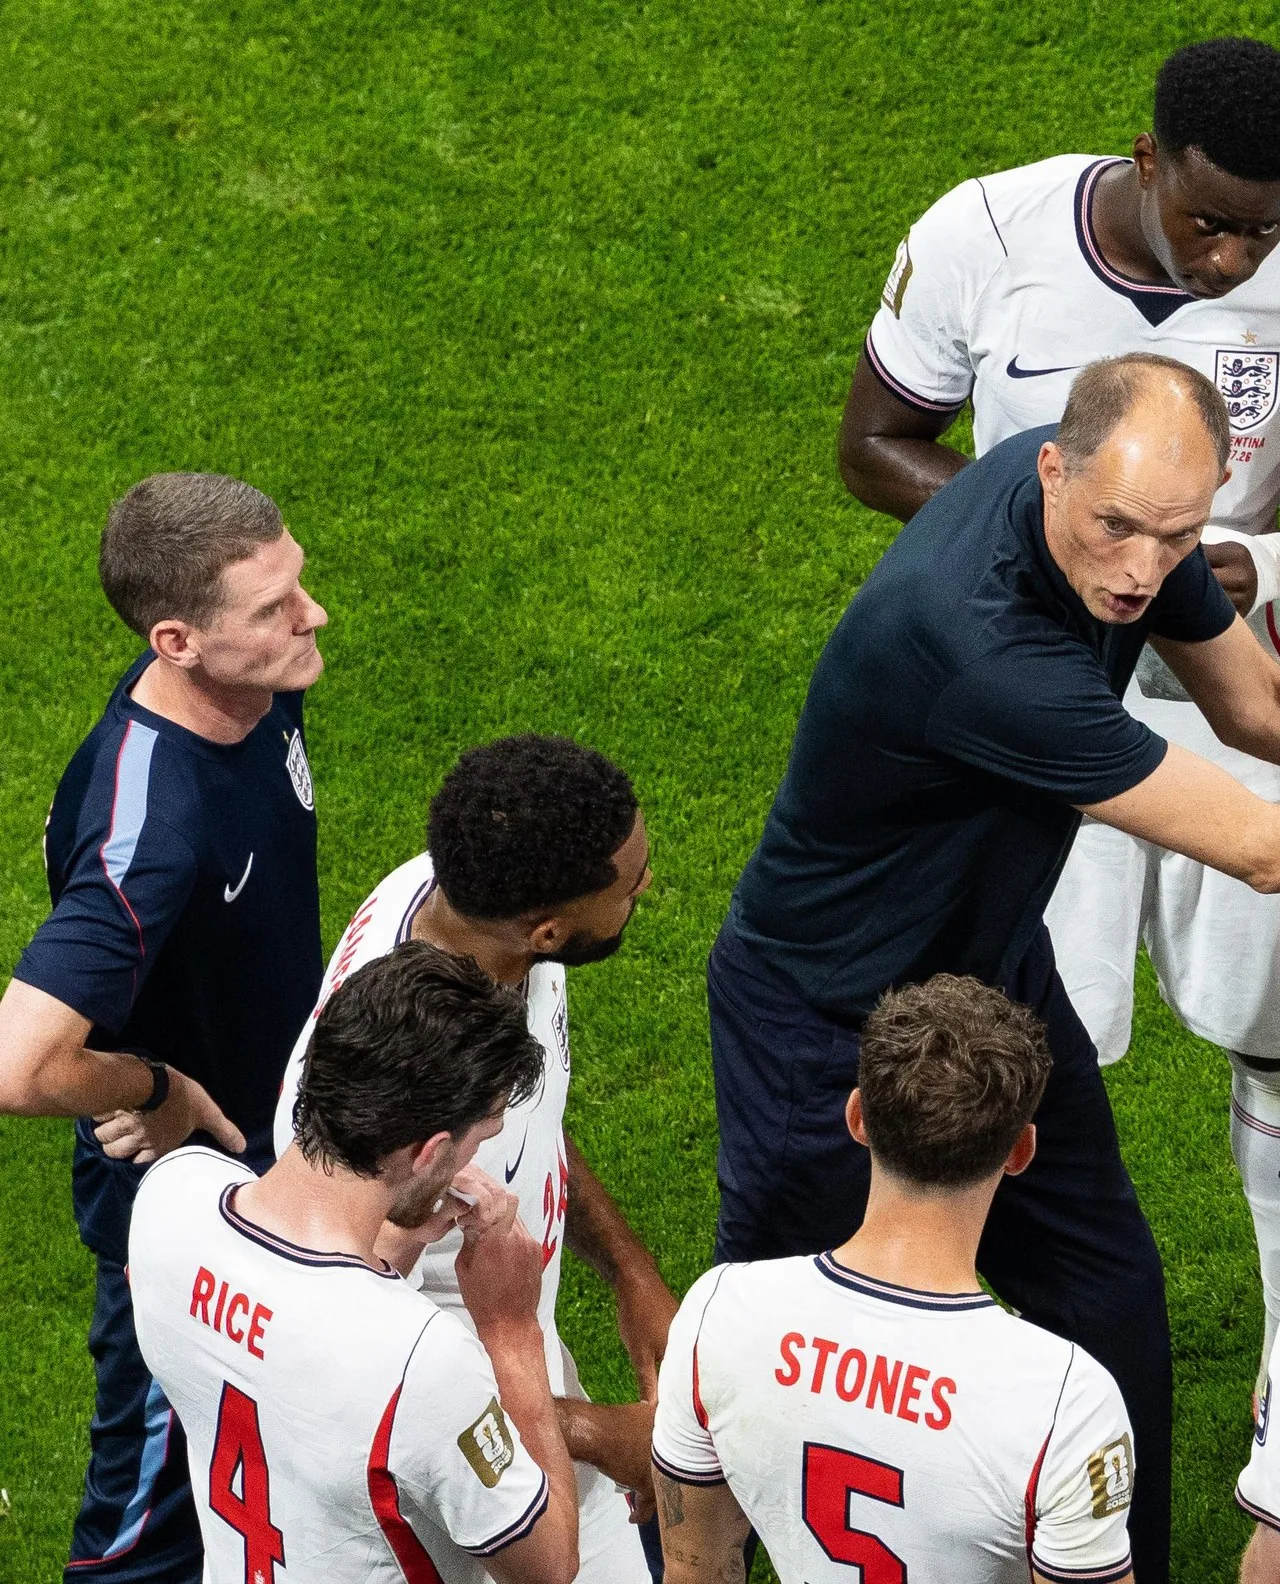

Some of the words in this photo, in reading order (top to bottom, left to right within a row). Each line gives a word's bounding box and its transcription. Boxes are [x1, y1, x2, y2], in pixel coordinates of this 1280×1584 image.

[1230, 436, 1266, 449] ENTINA
[1231, 450, 1252, 462] 7.26
[189, 1266, 274, 1360] RICE
[774, 1331, 957, 1431] STONES
[209, 1379, 286, 1584] 4
[801, 1441, 908, 1584] 5
